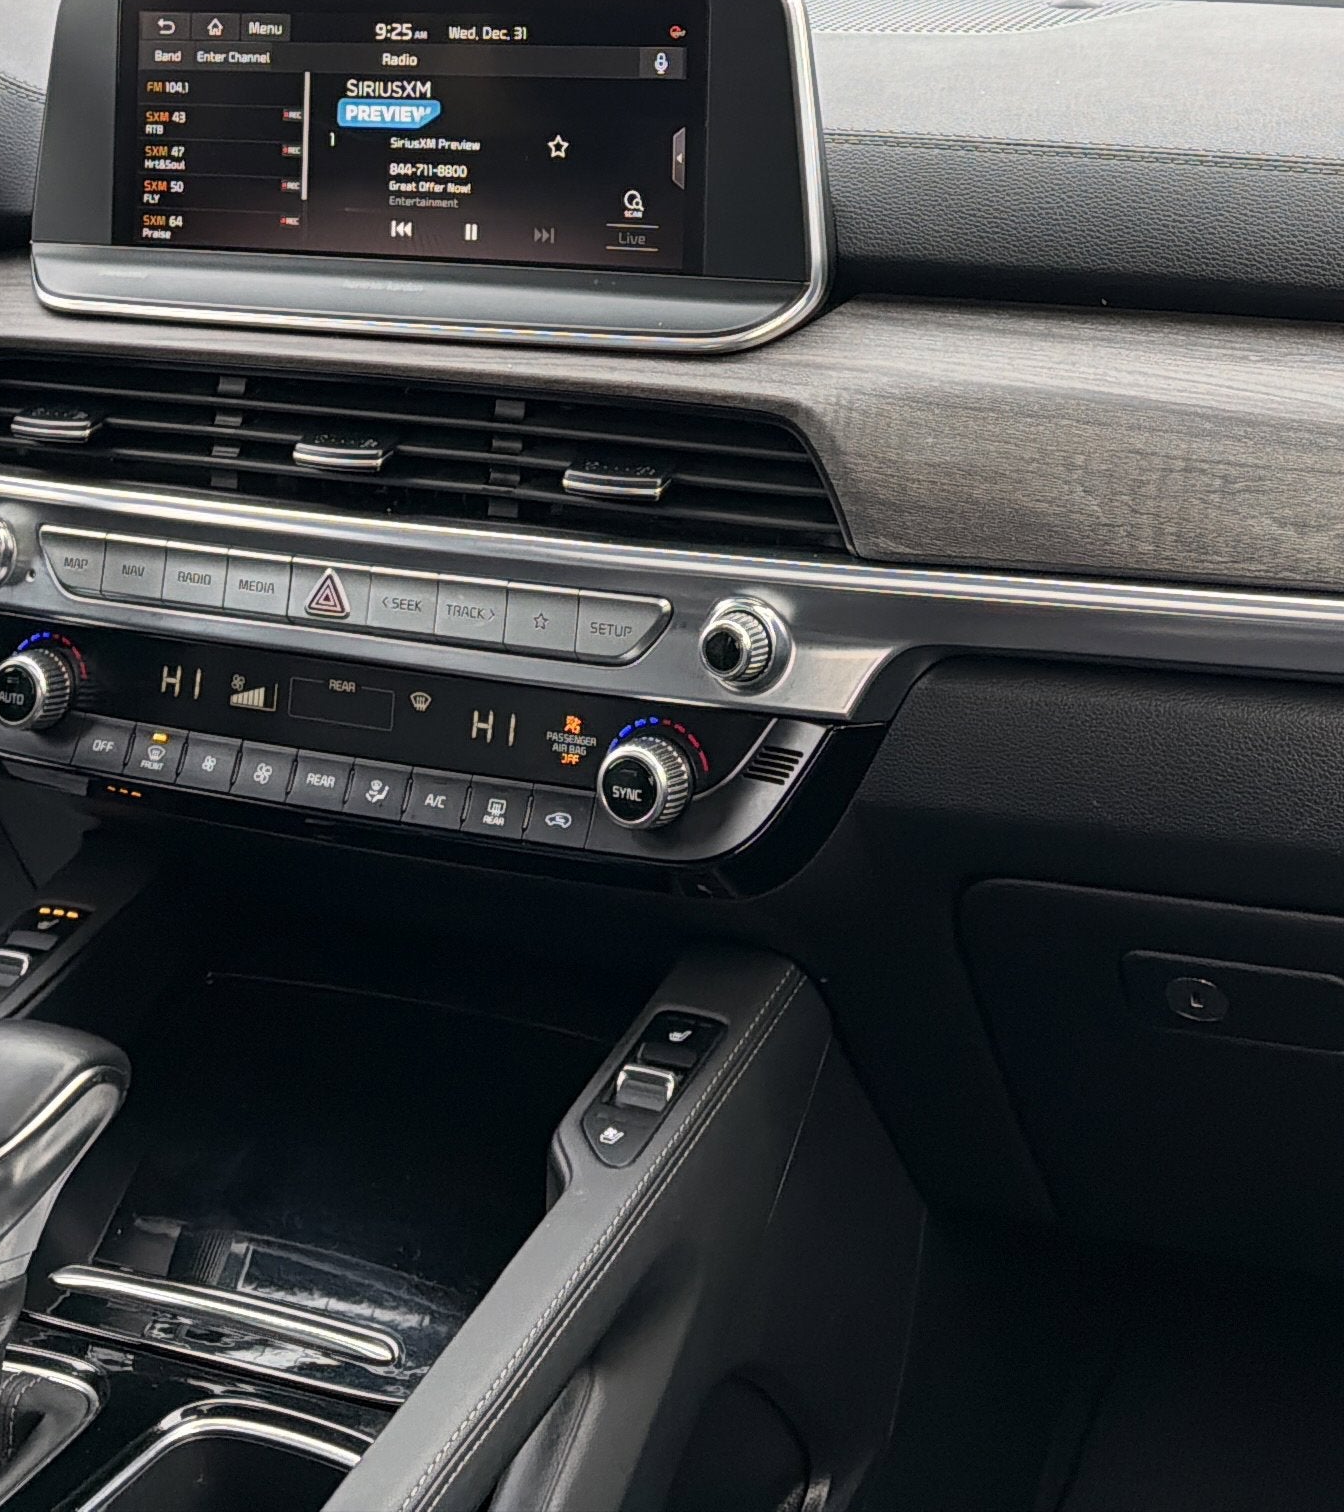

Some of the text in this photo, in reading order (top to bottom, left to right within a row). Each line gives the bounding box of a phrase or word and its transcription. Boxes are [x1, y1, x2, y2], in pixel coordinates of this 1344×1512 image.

[248, 21, 283, 36] Menu
[375, 23, 428, 40] 9:25 AM
[513, 26, 527, 40] 31
[154, 50, 182, 62] Band
[197, 51, 271, 64] Enter Channel
[382, 53, 418, 66] Radio
[146, 81, 189, 94] FM 104.1
[346, 79, 432, 98] SIRIUSXM
[146, 111, 186, 123] SXM 43
[345, 105, 432, 122] PREVIEW
[329, 131, 335, 147] 1
[390, 137, 481, 151] SiriusXM Preview
[144, 145, 185, 158] SXM 47
[389, 162, 468, 178] 844-711-8800
[143, 180, 184, 192] SXM 50
[389, 180, 417, 192] Great
[418, 181, 445, 193] Offer
[143, 193, 161, 204] FLY
[389, 195, 459, 208] Entertainment
[142, 214, 183, 227] SXM 64
[142, 227, 172, 239] Praise
[618, 231, 646, 245] Live
[63, 557, 89, 570] MAP
[121, 564, 146, 577] NAV
[177, 571, 212, 586] RADIO
[238, 579, 275, 594] MEDIA
[391, 598, 423, 612] SEEK
[446, 604, 485, 619] TRACK
[590, 621, 633, 637] SETUP
[328, 679, 356, 693] REAR
[92, 739, 114, 753] OFF
[546, 731, 597, 747] PASSENGER
[552, 742, 587, 756] AIR BAG
[140, 759, 164, 771] FRONT
[306, 772, 335, 789] REAR
[611, 785, 642, 802] SYNC
[424, 793, 446, 809] A/C
[482, 814, 505, 827] REAR
